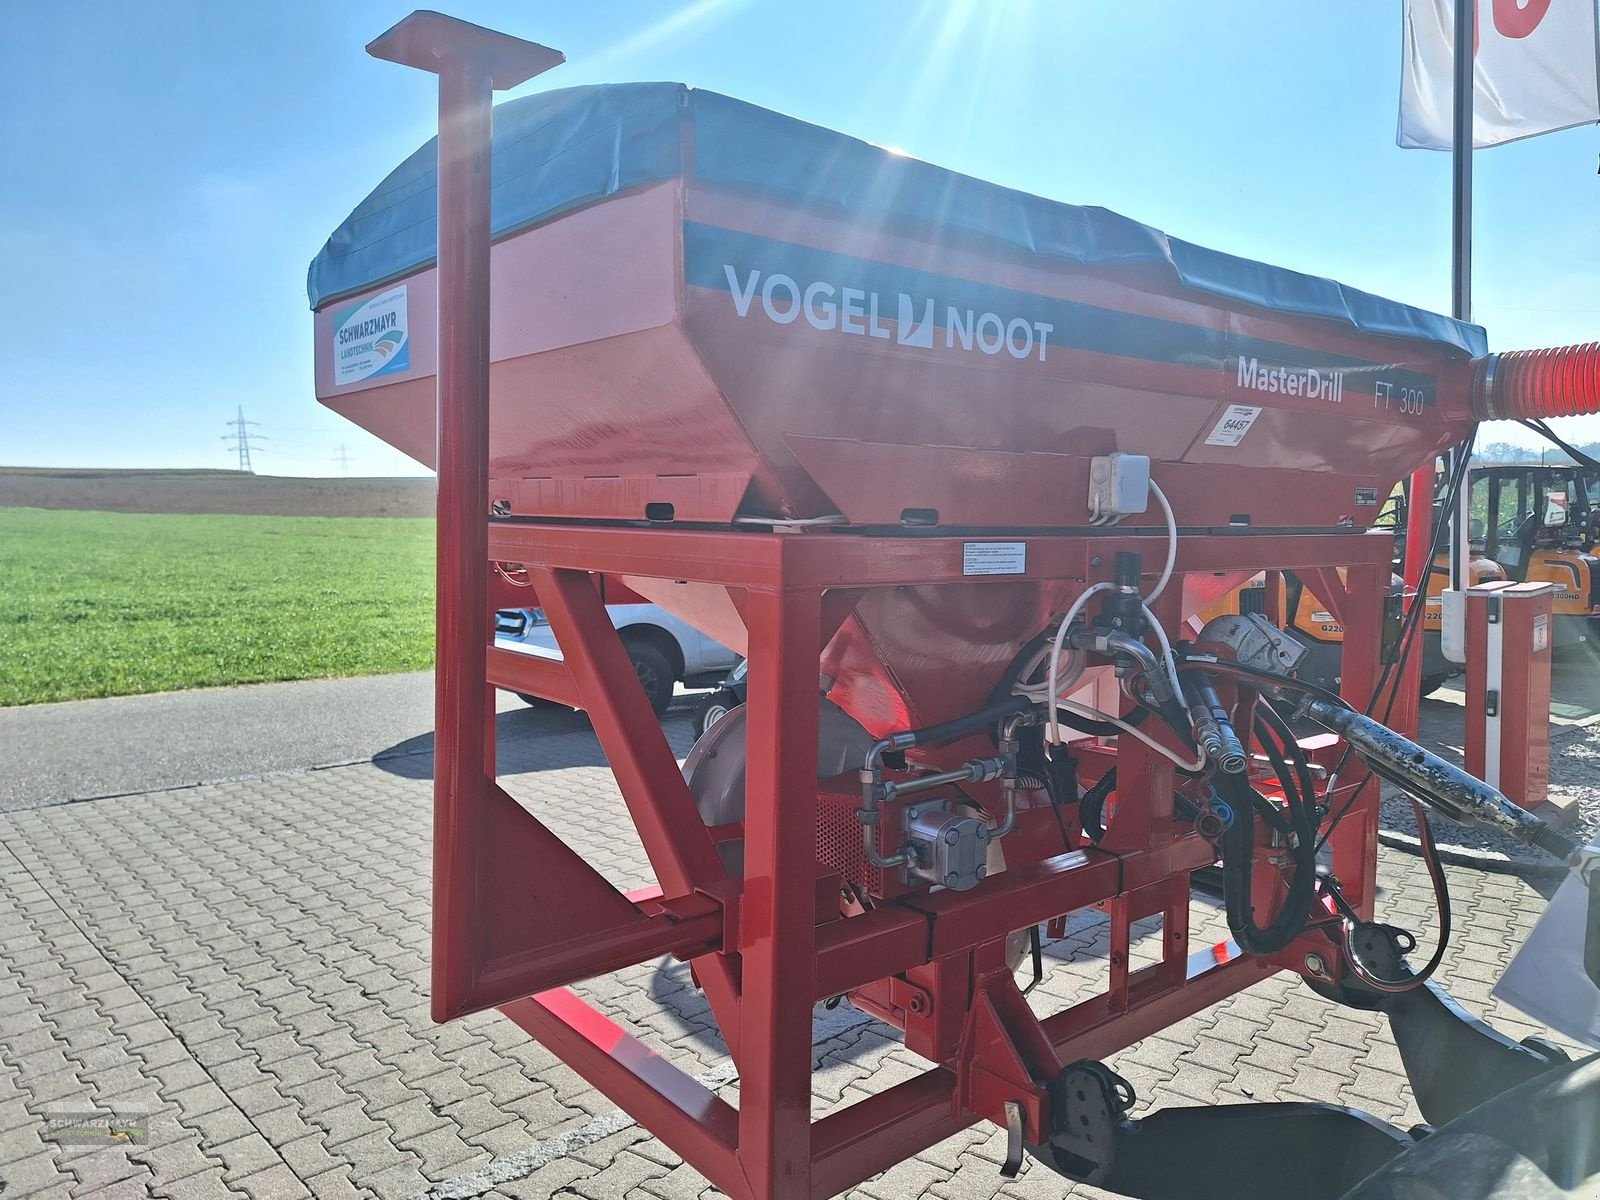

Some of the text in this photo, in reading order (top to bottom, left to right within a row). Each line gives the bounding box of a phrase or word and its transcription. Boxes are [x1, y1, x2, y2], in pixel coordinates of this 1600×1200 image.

[339, 311, 397, 344] SCHWARZMAYR
[723, 264, 1054, 361] VOGEL NOOT
[340, 341, 374, 359] LANDTECHNIK
[1237, 355, 1344, 402] MasterDrill
[1374, 380, 1424, 416] FT 300
[1223, 418, 1251, 431] 64457
